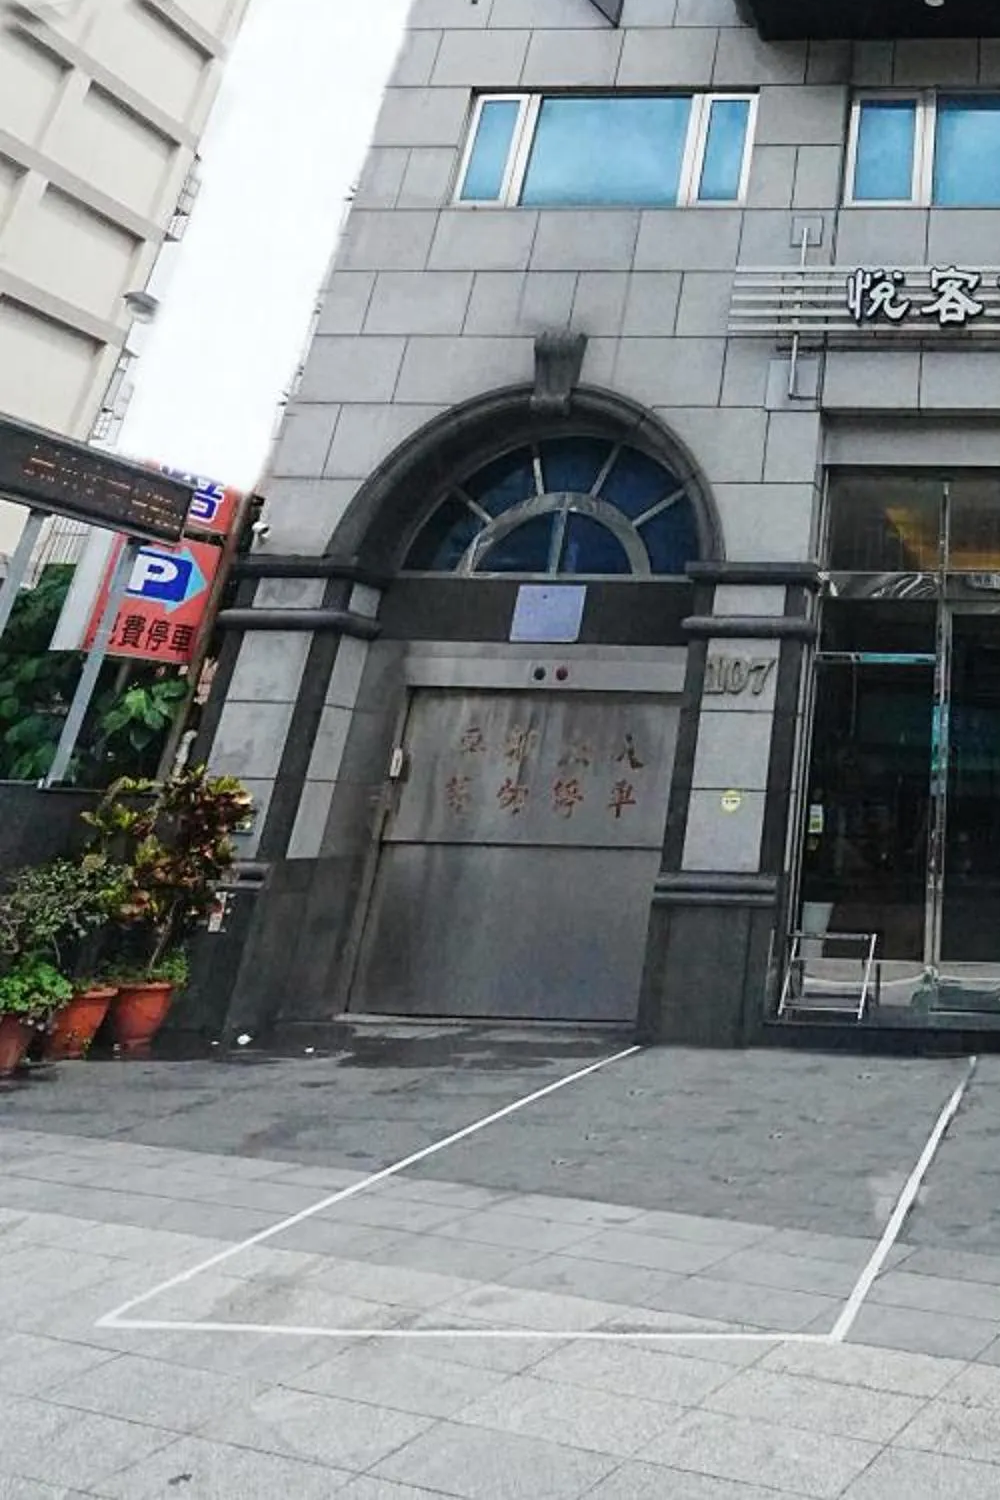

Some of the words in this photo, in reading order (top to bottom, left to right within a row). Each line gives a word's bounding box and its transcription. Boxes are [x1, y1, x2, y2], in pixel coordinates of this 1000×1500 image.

[128, 551, 179, 592] P
[90, 609, 196, 656] 費停車
[703, 656, 777, 696] 107
